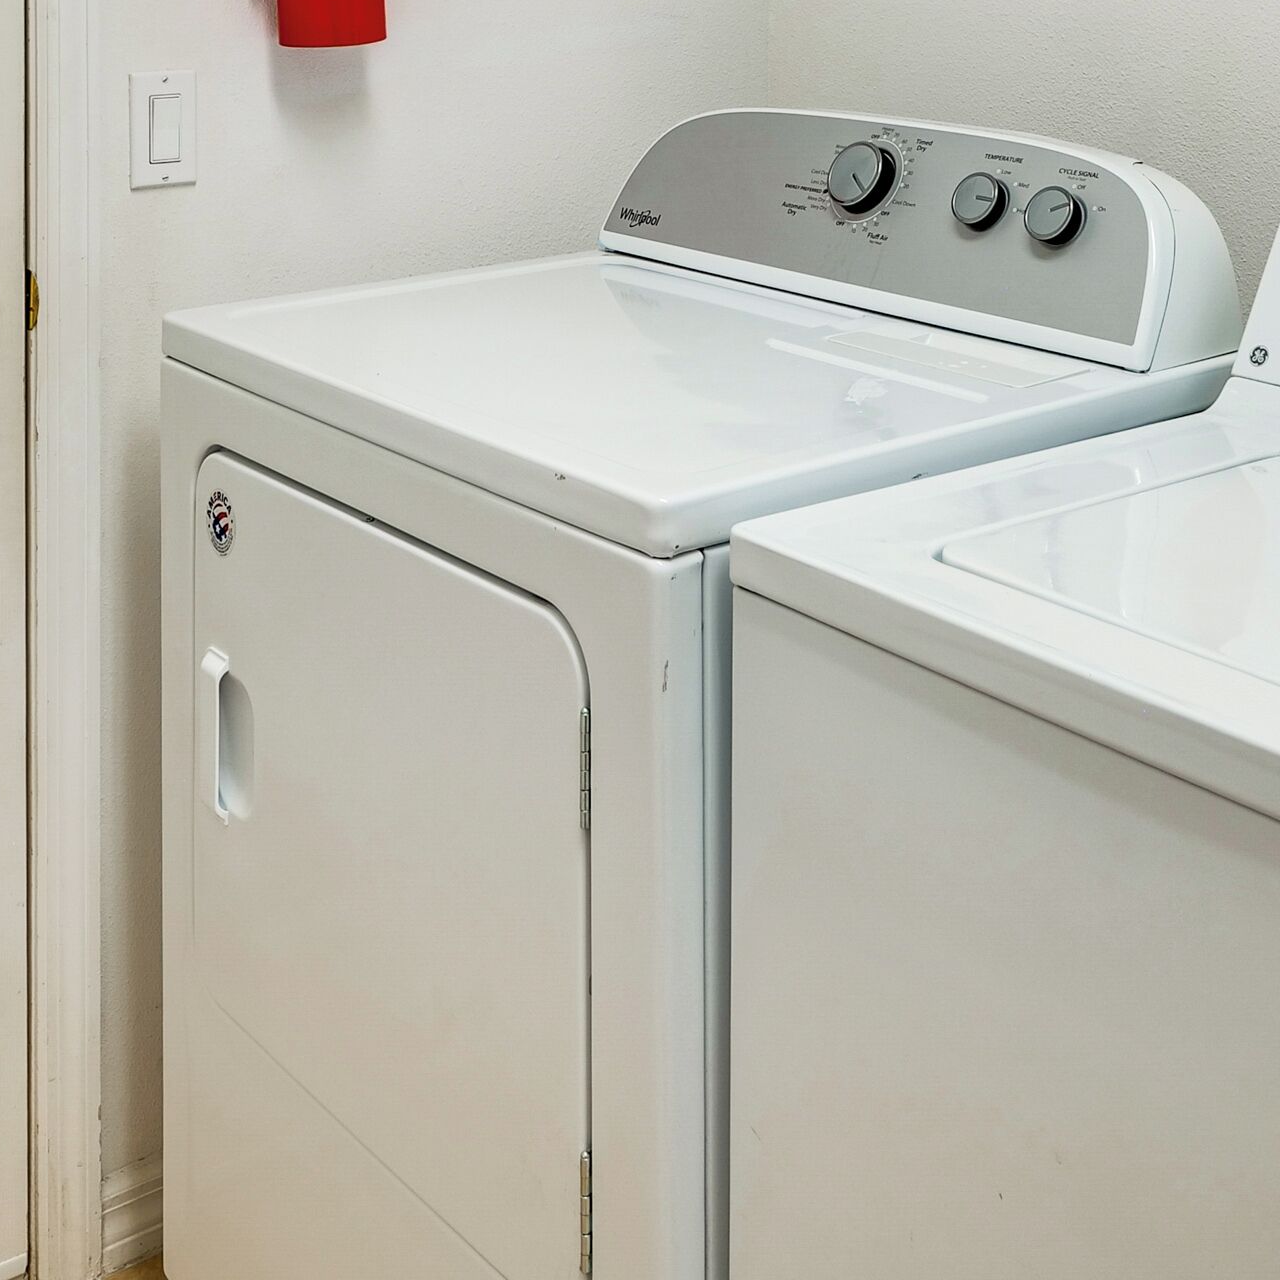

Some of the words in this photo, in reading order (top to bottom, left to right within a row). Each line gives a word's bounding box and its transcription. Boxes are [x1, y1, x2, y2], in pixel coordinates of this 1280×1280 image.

[916, 138, 933, 146] Timed
[985, 154, 1024, 164] TEMPERATURE
[1059, 168, 1077, 176] CYCLE
[1078, 170, 1100, 178] SIGNAL
[782, 202, 807, 210] Automatic
[620, 207, 661, 227] Whirlpool
[206, 491, 232, 520] AMERICA
